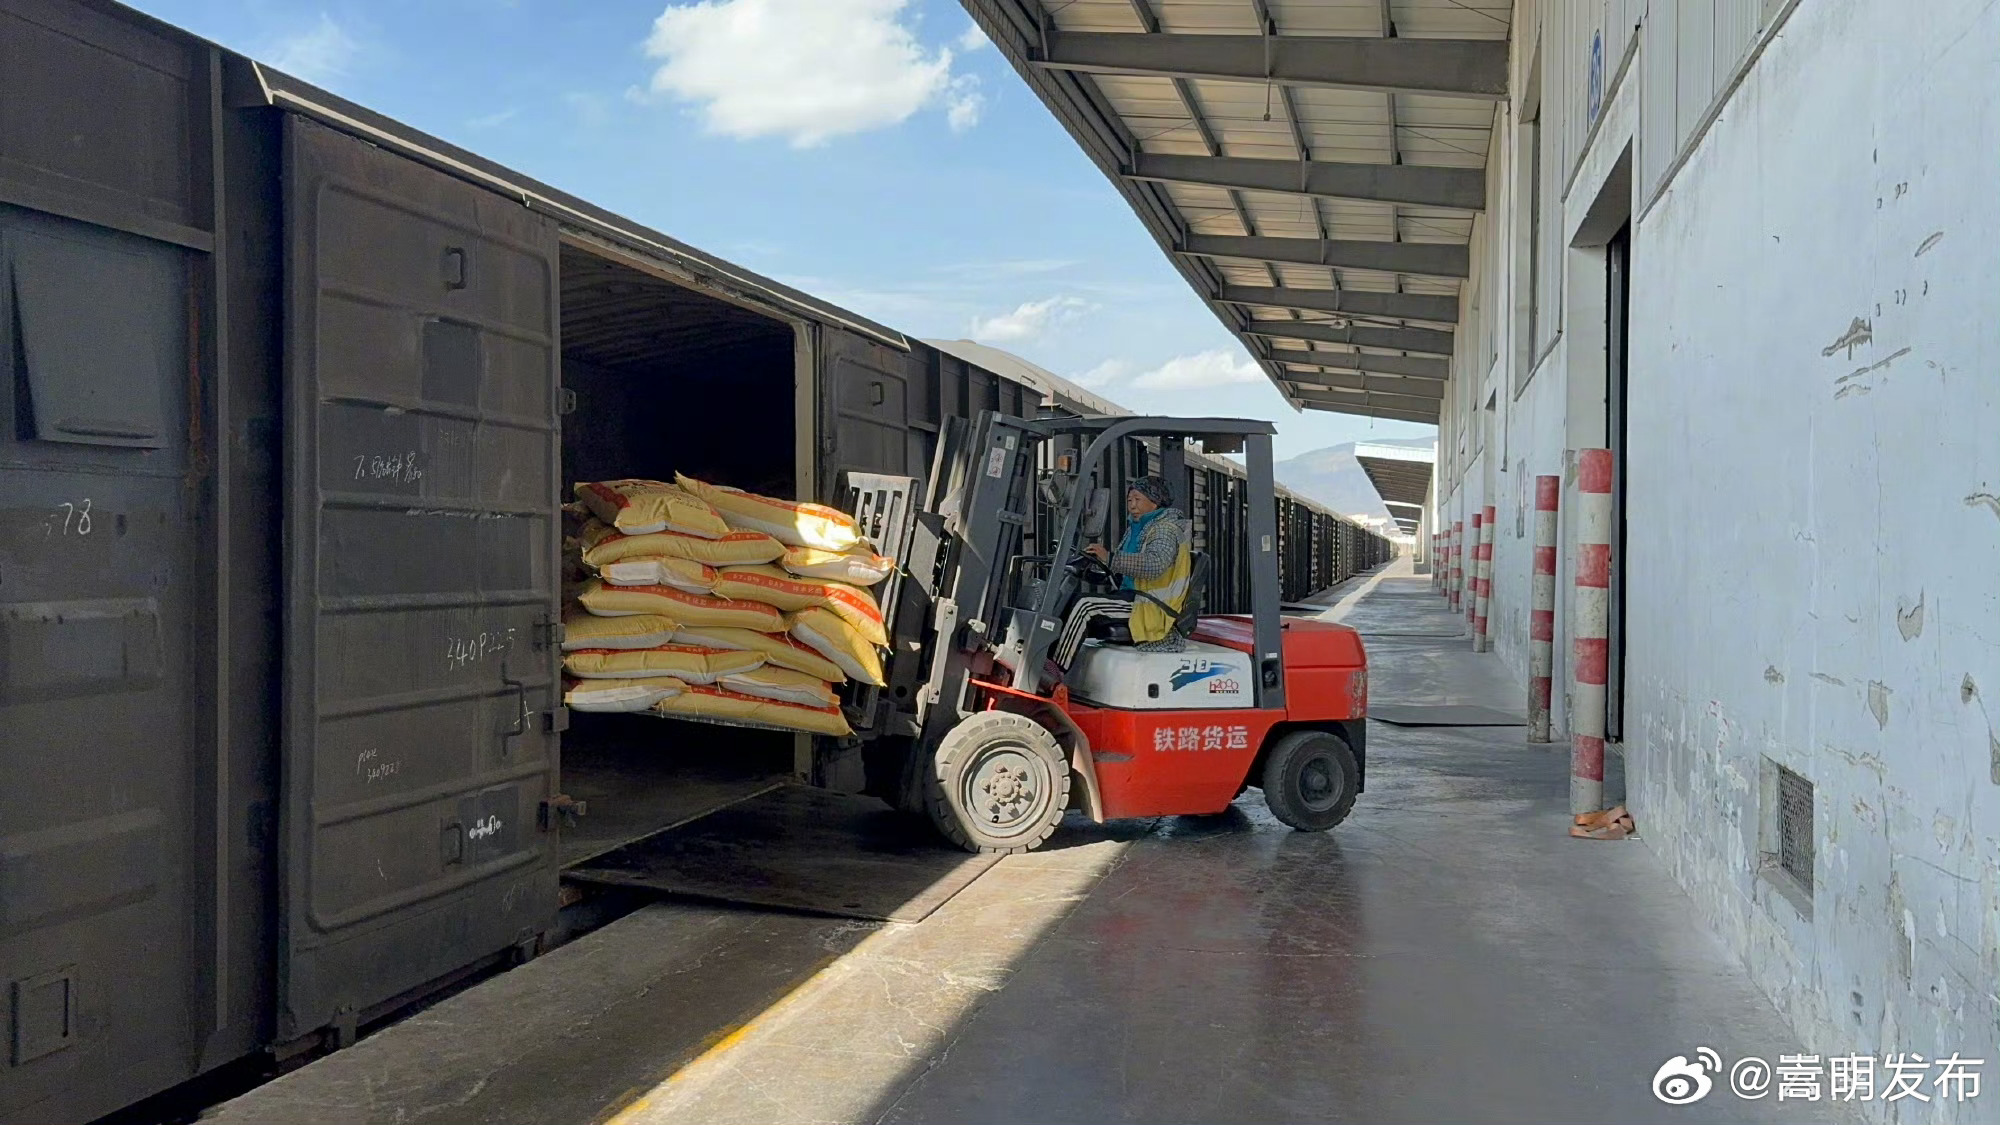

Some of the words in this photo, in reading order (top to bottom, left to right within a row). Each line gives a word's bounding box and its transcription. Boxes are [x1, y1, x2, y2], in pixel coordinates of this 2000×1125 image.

[1180, 657, 1212, 674] 30
[1153, 725, 1249, 752] 铁路货运
